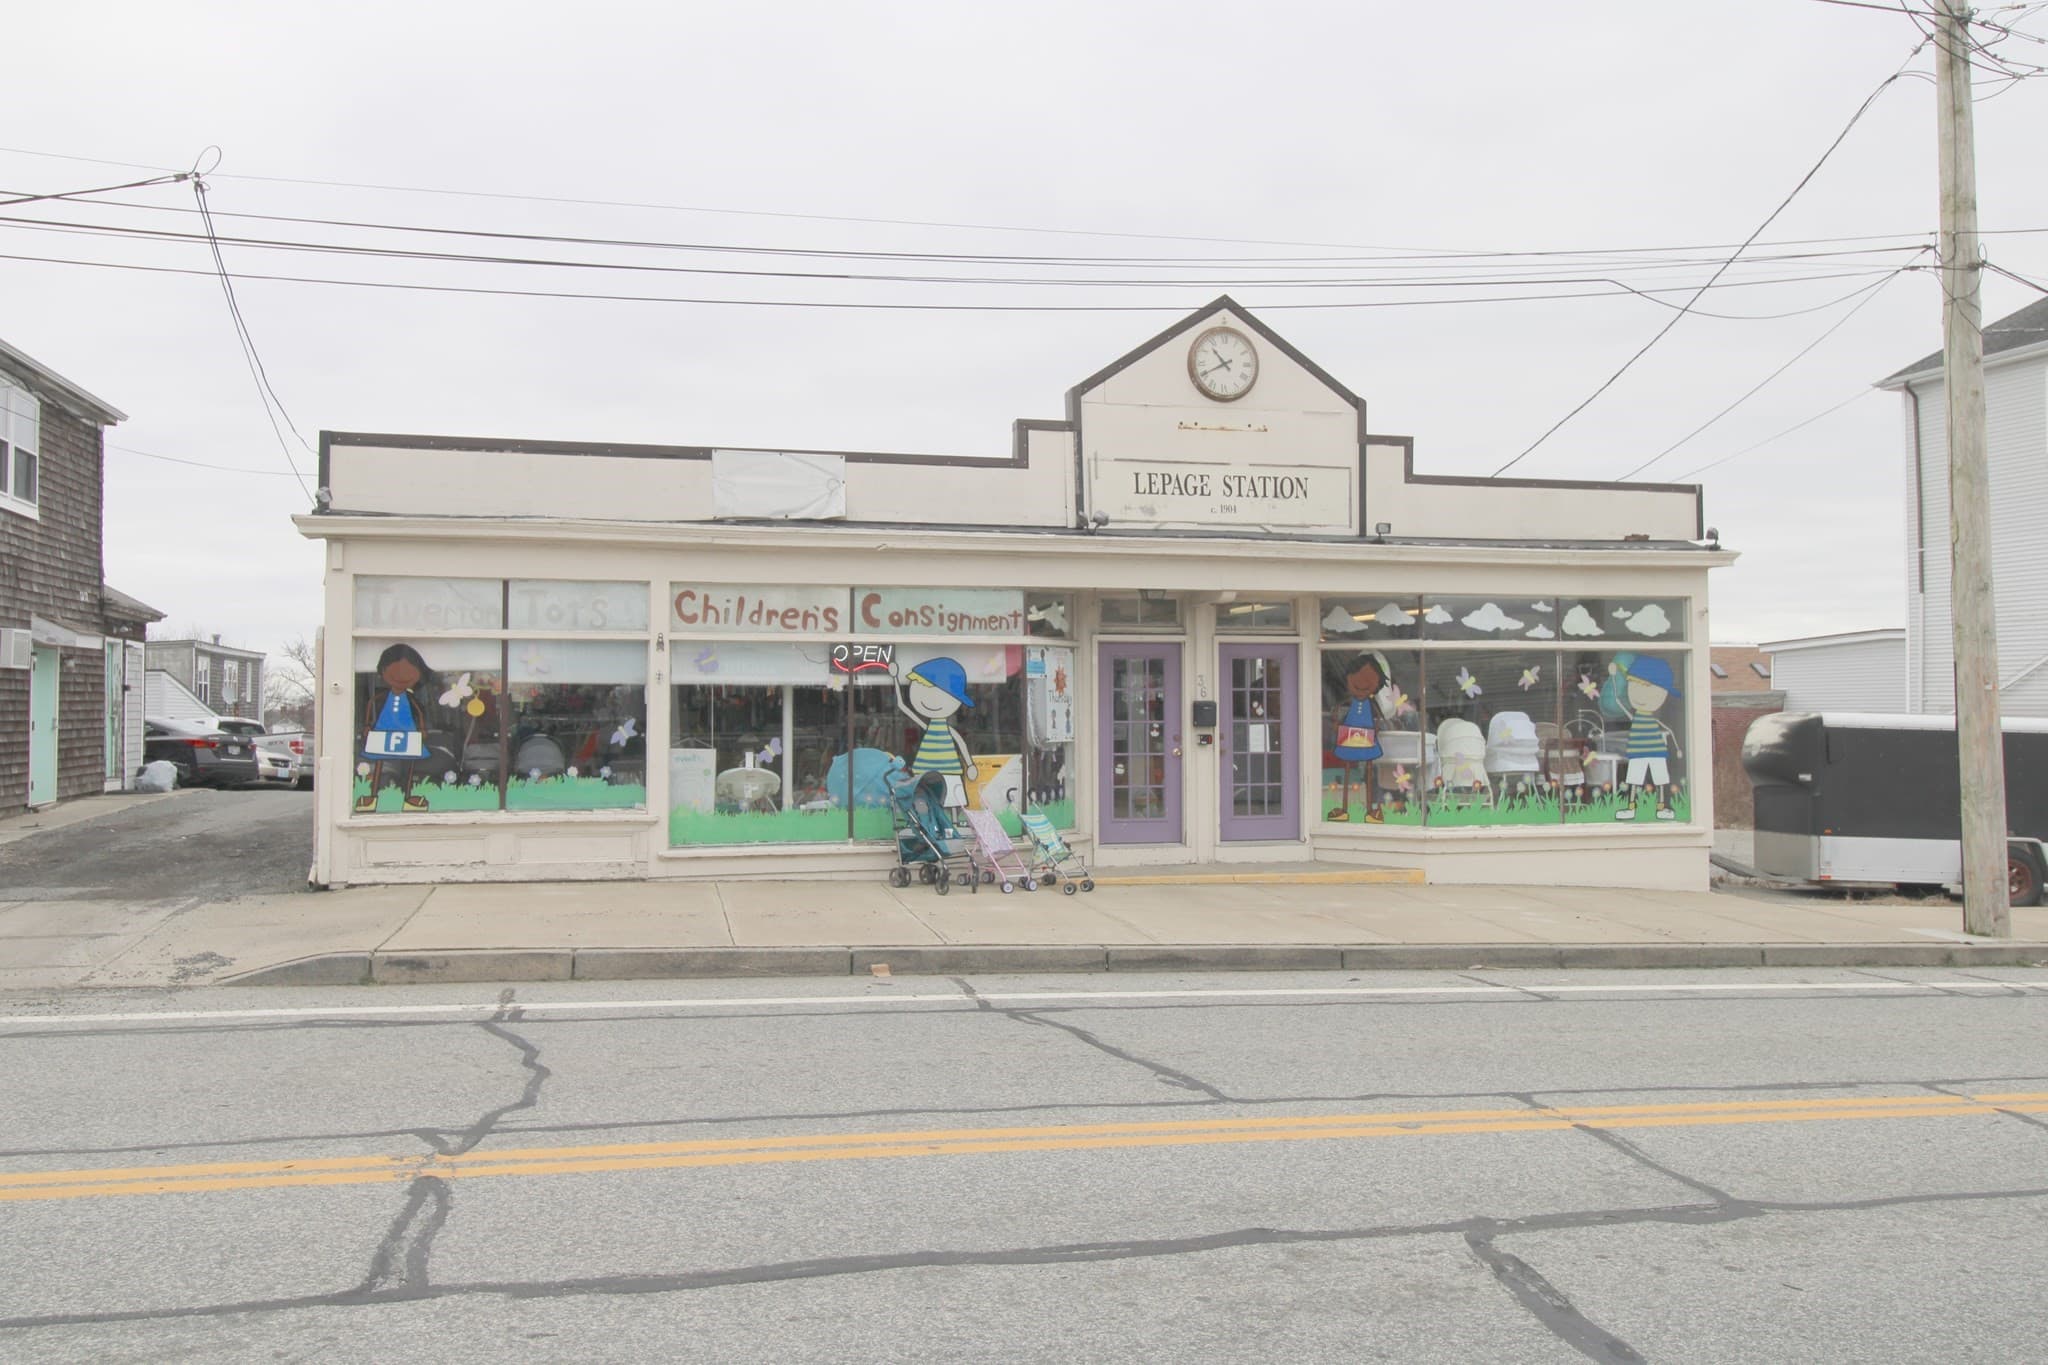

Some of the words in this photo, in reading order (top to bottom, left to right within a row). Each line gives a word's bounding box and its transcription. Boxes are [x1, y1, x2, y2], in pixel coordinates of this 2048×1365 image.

[1133, 472, 1211, 497] LEPAGE
[1222, 475, 1309, 499] STATION
[674, 590, 839, 633] Children's
[861, 592, 1022, 632] Consignment
[833, 645, 892, 663] OPEN
